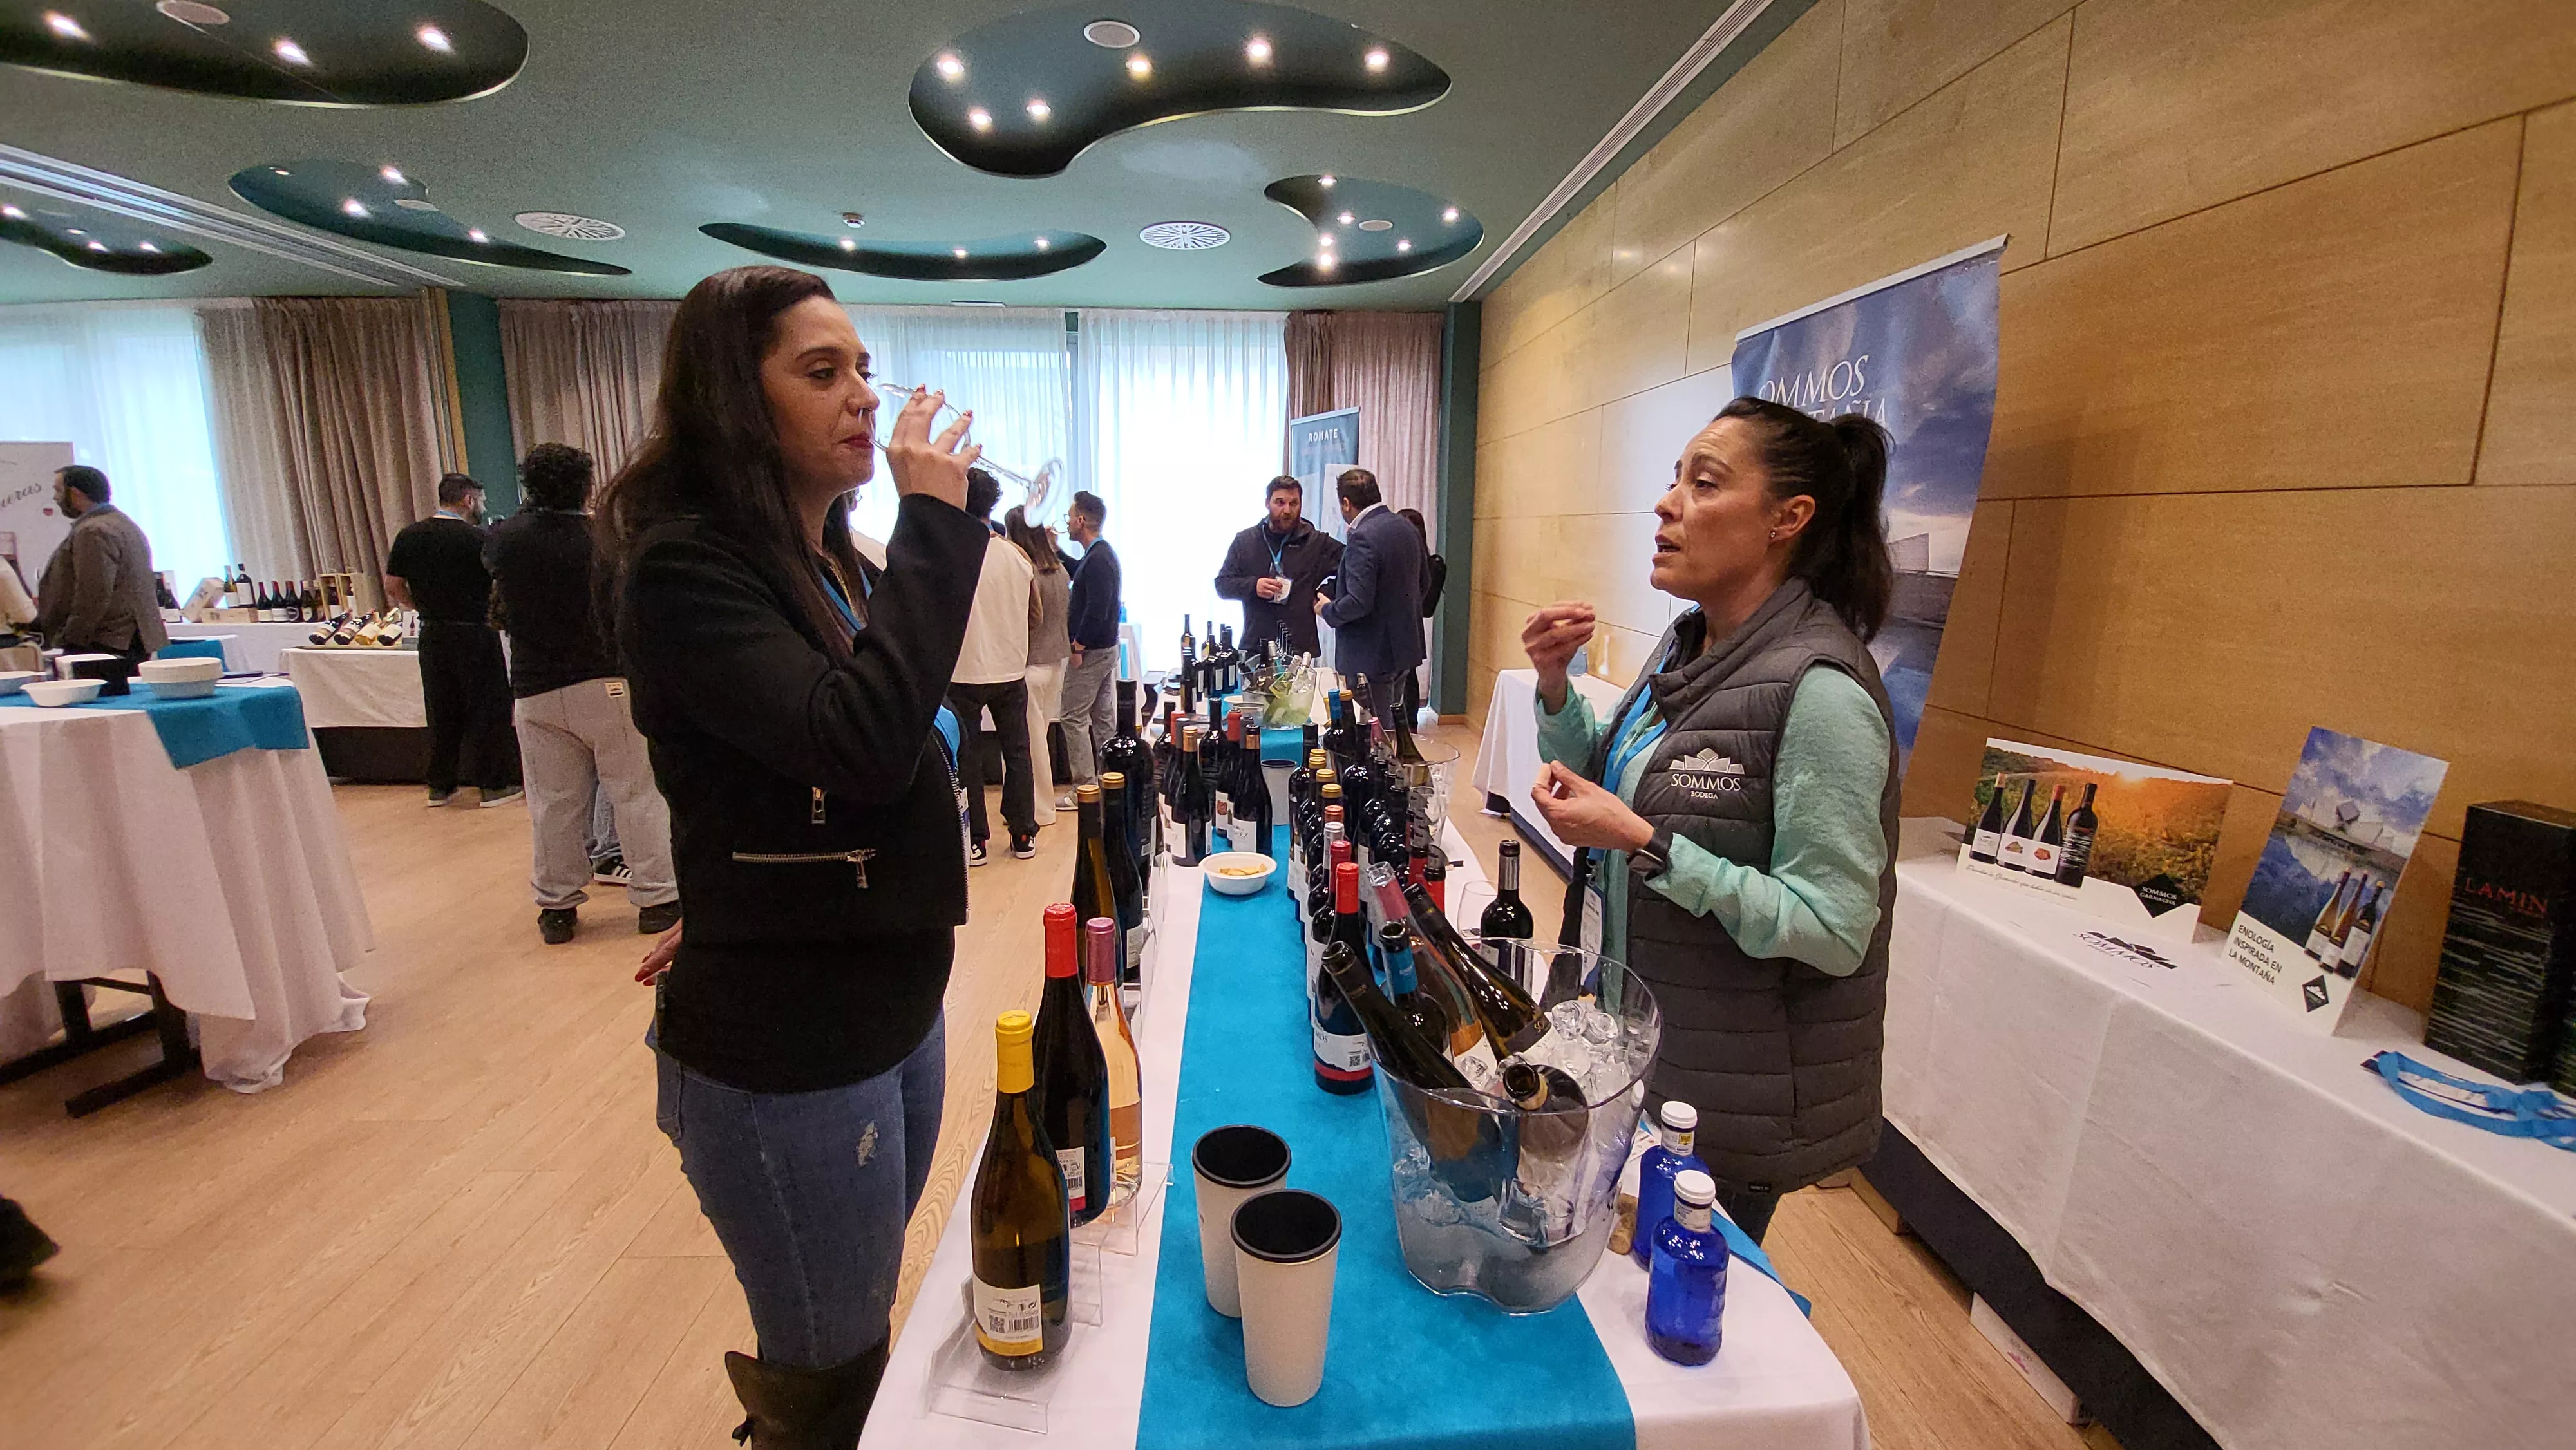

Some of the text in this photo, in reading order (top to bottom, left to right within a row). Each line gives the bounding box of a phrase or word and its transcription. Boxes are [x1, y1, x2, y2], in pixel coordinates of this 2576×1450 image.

[1759, 355, 1869, 410] OMMOS
[1308, 428, 1338, 442] ROMATE
[1671, 773, 1741, 791] SOMMOS
[1690, 791, 1718, 800] BODEGA
[2139, 892, 2176, 906] GARNACHA
[2142, 886, 2177, 900] SOMMOS
[2238, 925, 2274, 953] ENOLOGÍA
[2233, 936, 2283, 974] INSPIRADA EN
[2228, 948, 2275, 985] LA MONTAÑA
